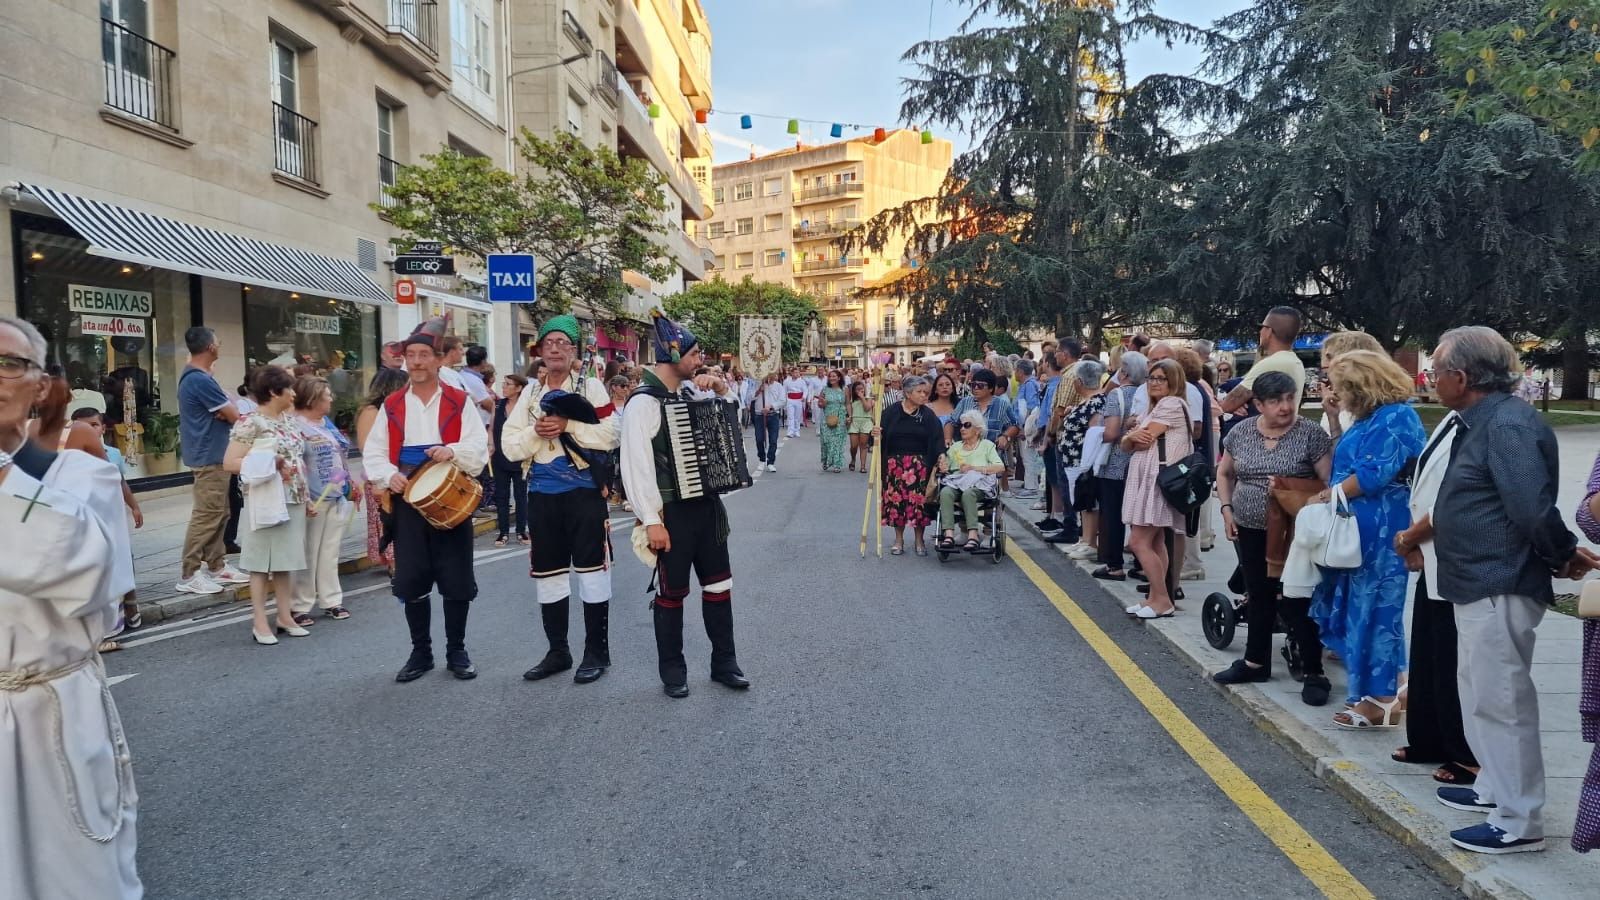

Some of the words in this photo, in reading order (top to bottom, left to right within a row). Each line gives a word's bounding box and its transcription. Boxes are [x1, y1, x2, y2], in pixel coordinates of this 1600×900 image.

[406, 260, 440, 272] LEDGO
[492, 272, 532, 287] TAXI
[73, 289, 150, 313] REBAIXAS
[297, 317, 338, 332] REBAIXAS
